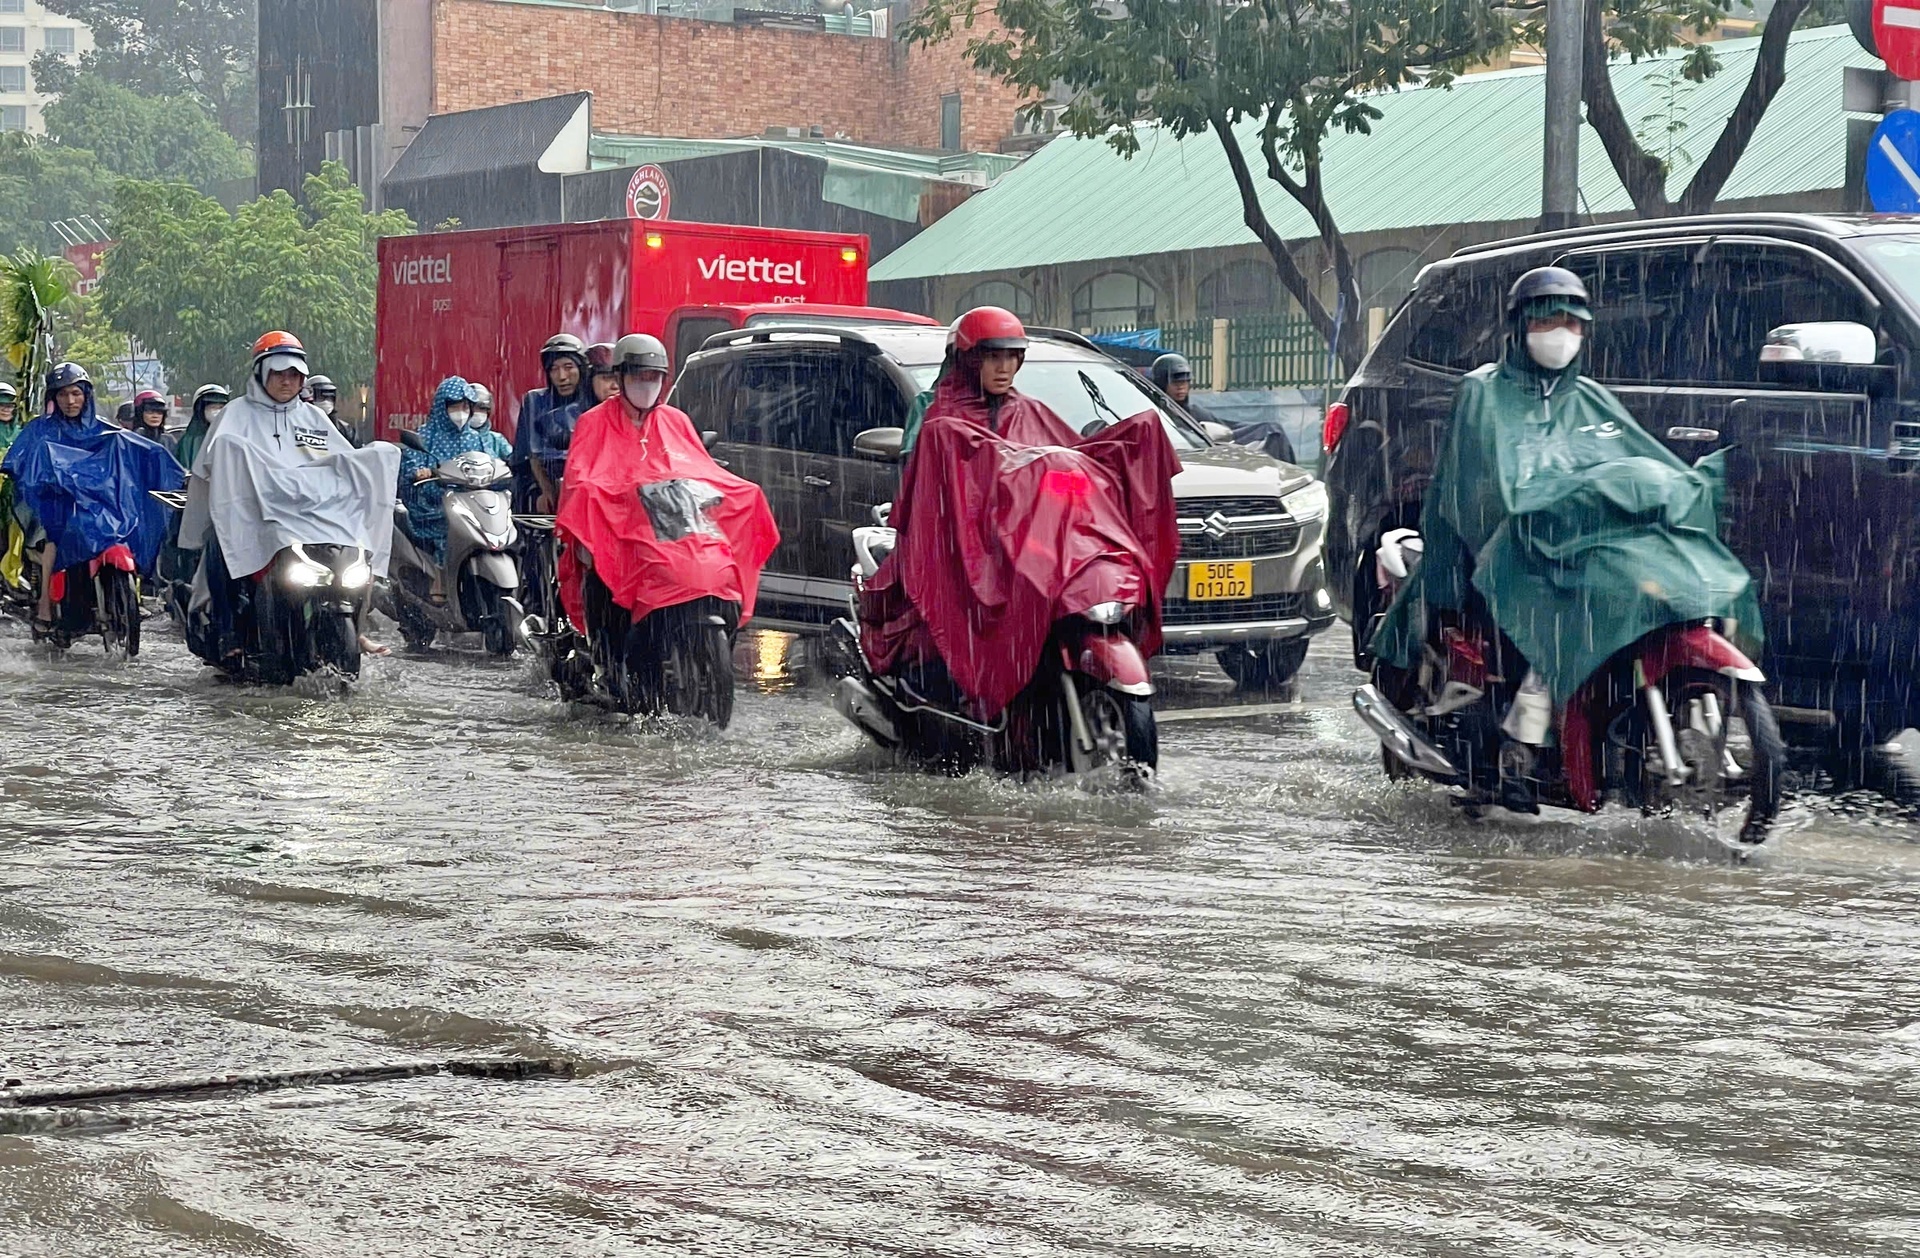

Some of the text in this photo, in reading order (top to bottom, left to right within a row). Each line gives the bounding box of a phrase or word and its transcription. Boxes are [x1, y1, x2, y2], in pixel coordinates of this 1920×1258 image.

[628, 170, 667, 200] HIGHLANDS
[393, 253, 452, 285] viettel
[697, 254, 806, 285] viettel
[295, 434, 327, 446] TITAN
[1207, 564, 1235, 579] 50E
[1196, 581, 1246, 598] 013.02
